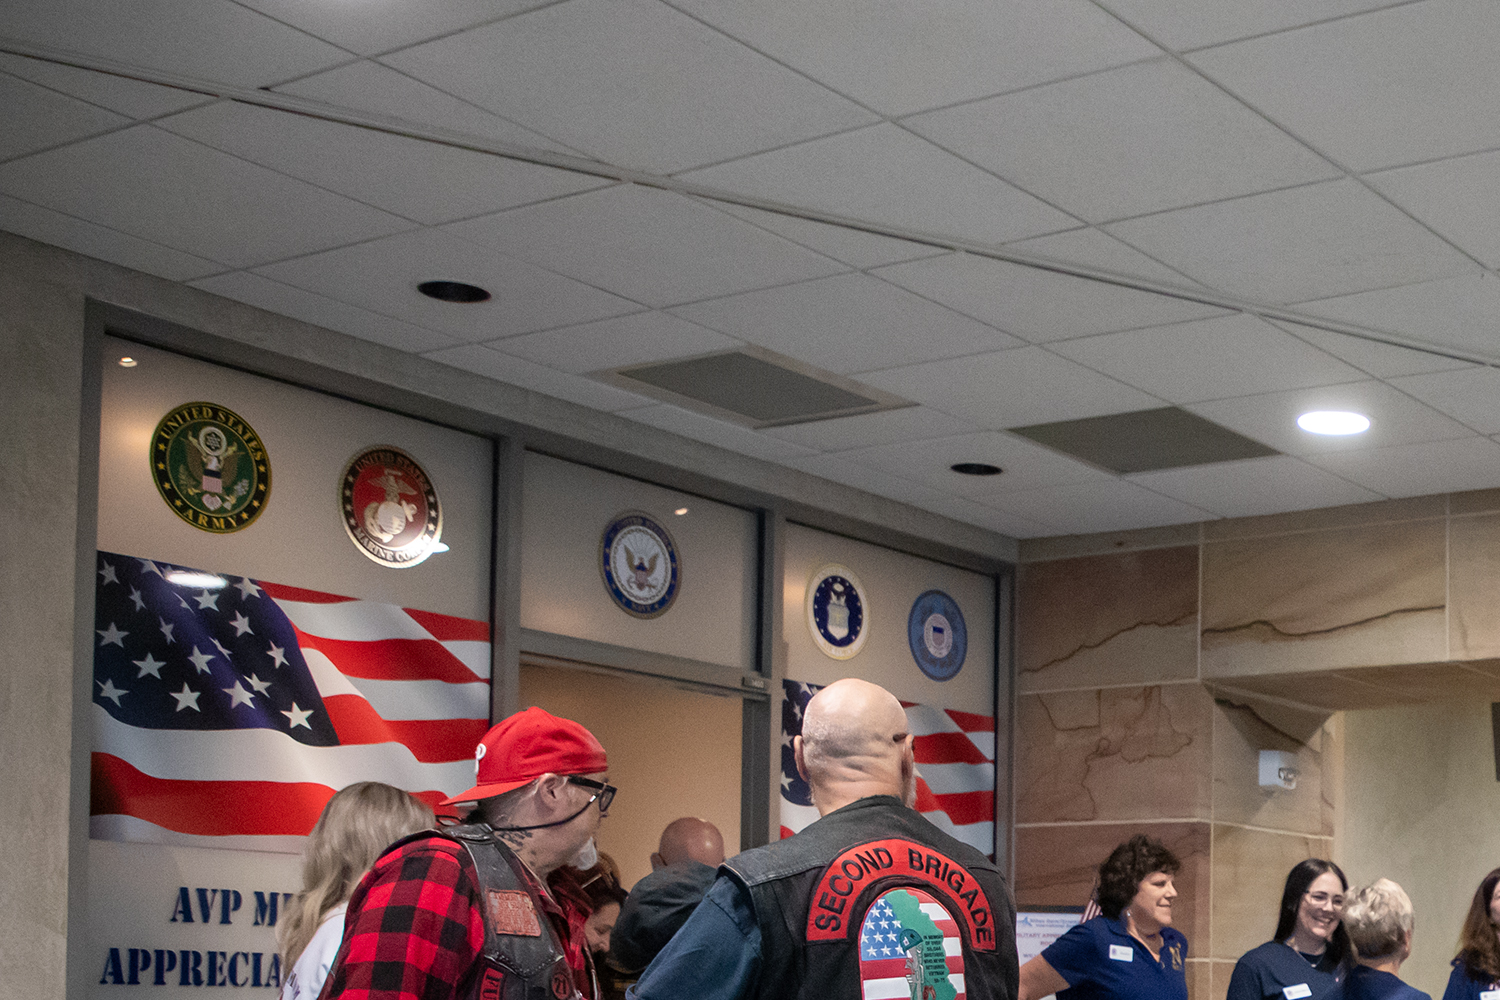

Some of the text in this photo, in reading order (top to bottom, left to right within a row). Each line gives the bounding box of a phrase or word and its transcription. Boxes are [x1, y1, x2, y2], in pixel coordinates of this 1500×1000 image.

[161, 406, 264, 461] UNITED STATES
[183, 507, 238, 530] ARMY
[353, 528, 394, 561] MARINE
[170, 886, 243, 925] AVP
[815, 847, 993, 944] SECOND BRIGADE
